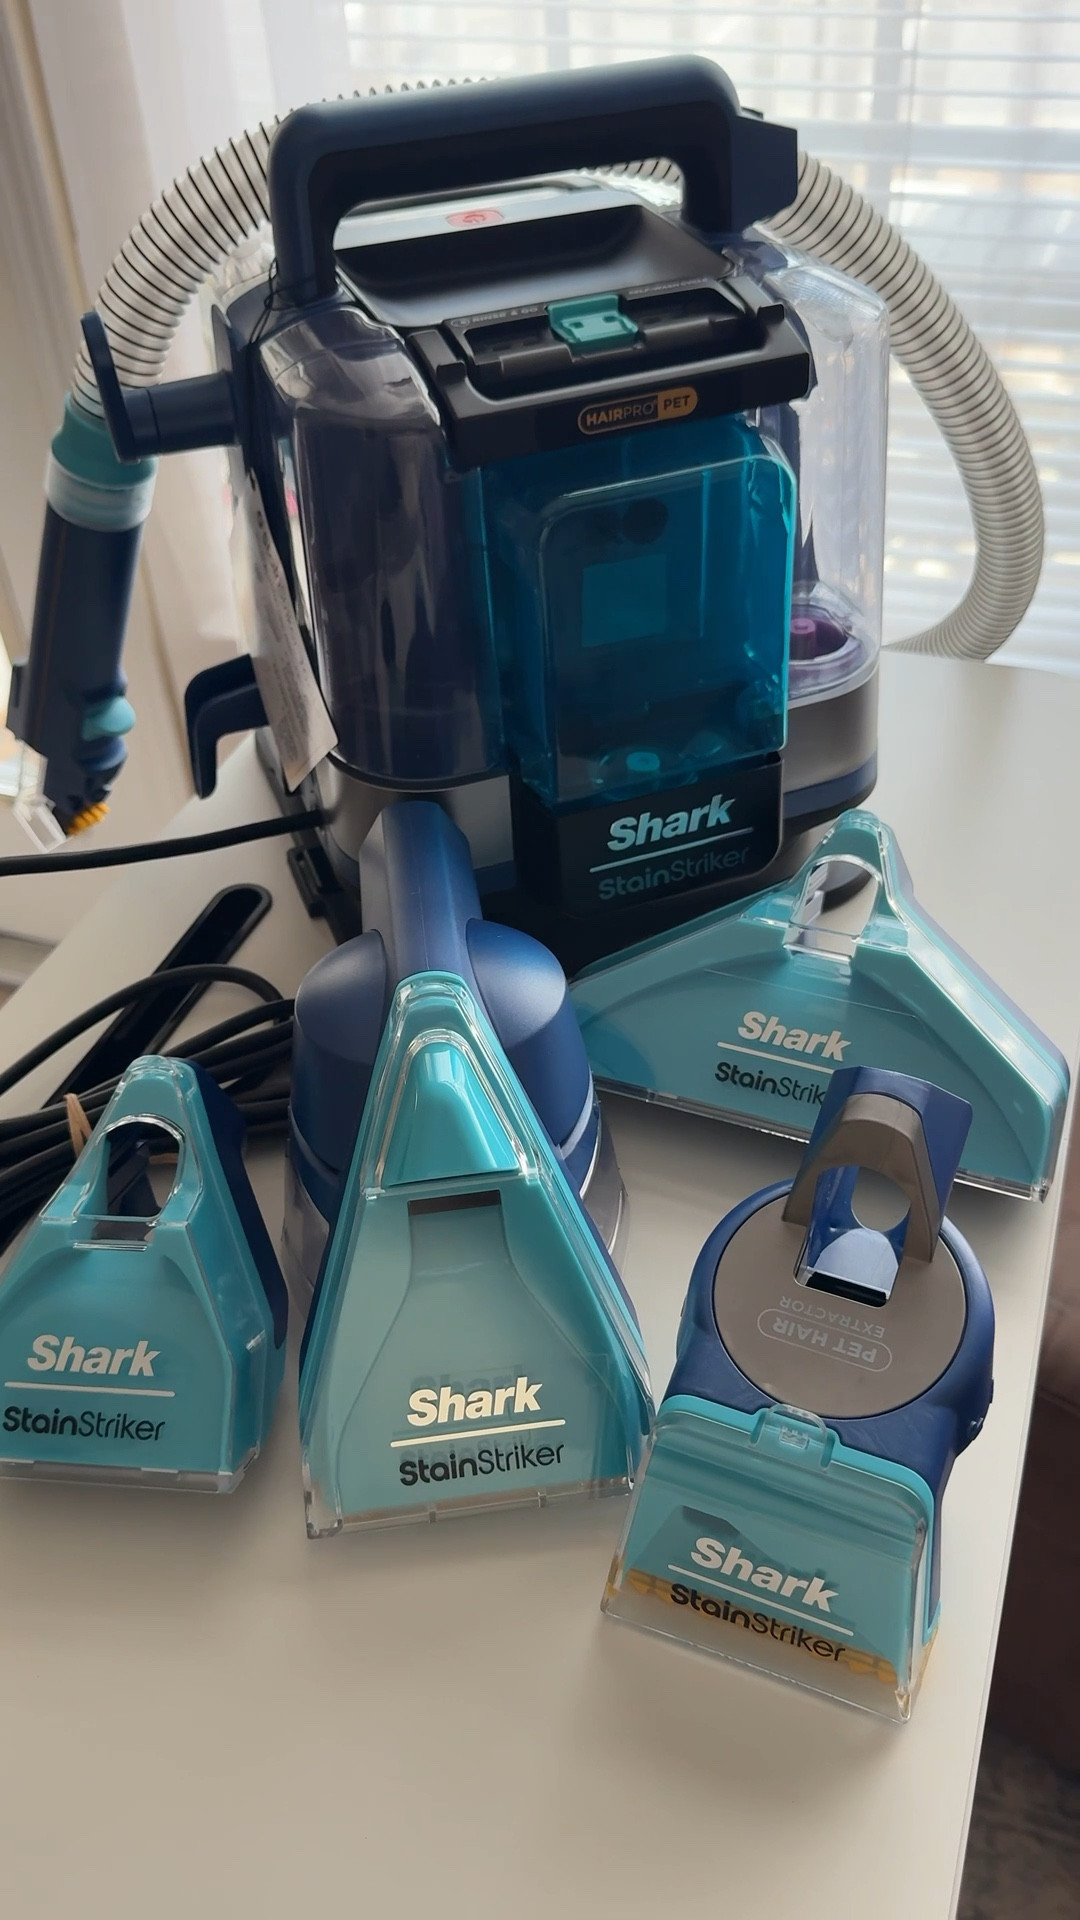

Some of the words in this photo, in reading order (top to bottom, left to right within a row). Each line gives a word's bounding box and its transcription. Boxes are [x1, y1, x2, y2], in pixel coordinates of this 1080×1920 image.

[663, 394, 690, 411] PET
[607, 794, 736, 851] Shark
[598, 846, 750, 900] StainStriker
[738, 1011, 851, 1062] Shark
[714, 1062, 827, 1106] StainStrik
[772, 1316, 828, 1347] HAIR
[779, 1295, 885, 1339] EXTRACTOR
[27, 1334, 161, 1377] Shark
[832, 1337, 877, 1363] PET
[2, 1406, 166, 1441] StainStriker
[407, 1376, 543, 1427] Shark
[399, 1444, 565, 1487] StainStriker
[690, 1537, 839, 1613] Shark
[670, 1583, 846, 1662] StainStriker
